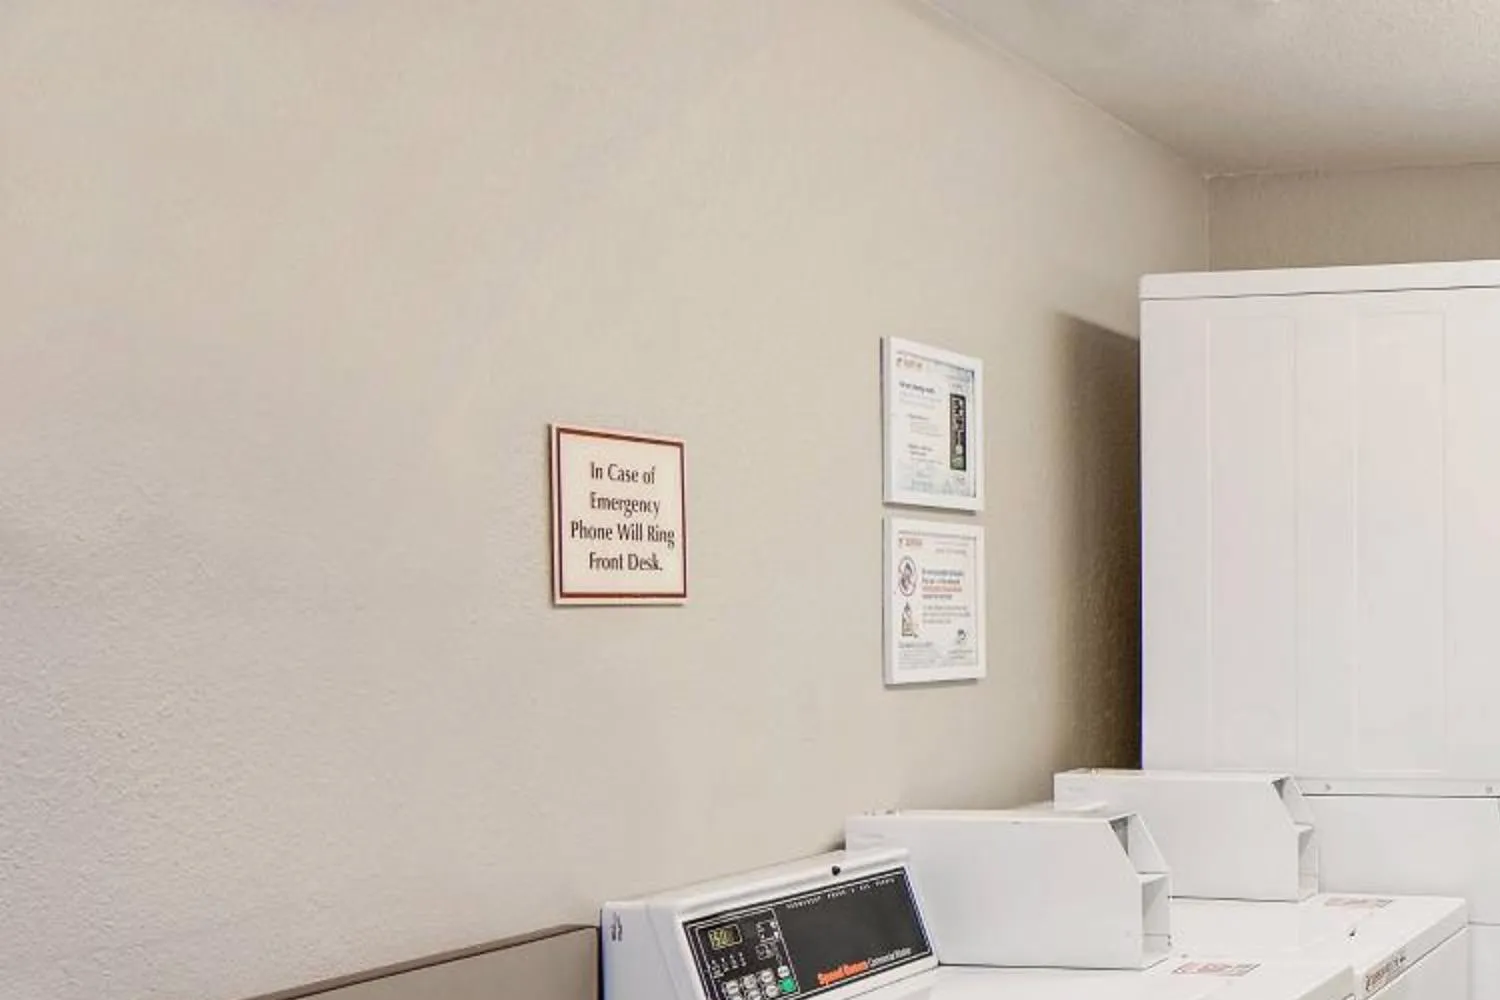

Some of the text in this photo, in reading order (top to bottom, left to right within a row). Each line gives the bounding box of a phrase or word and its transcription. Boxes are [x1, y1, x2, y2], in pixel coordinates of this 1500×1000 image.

[590, 461, 656, 484] In Case of
[590, 491, 660, 520] Emergency
[571, 519, 675, 550] Phone Will Ring
[589, 551, 664, 571] Front Desk.
